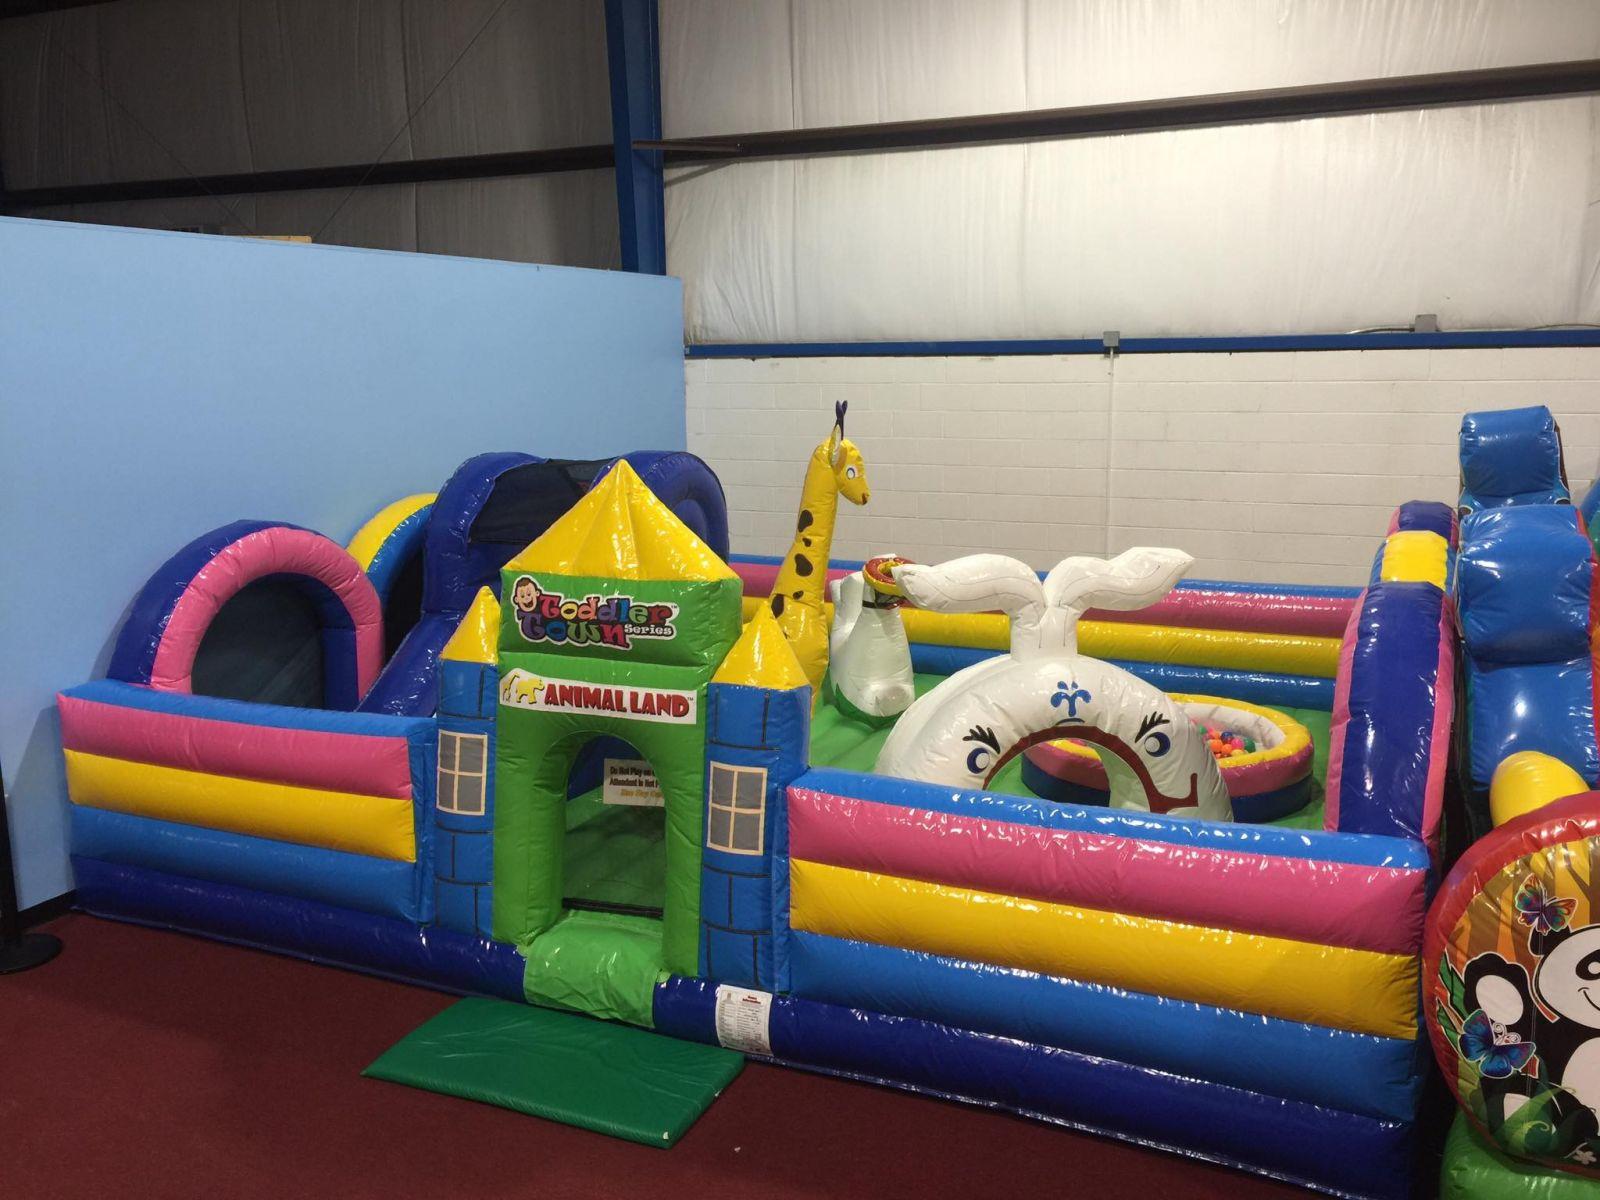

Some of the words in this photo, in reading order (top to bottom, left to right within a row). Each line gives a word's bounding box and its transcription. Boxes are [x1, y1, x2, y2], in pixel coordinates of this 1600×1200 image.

[539, 595, 673, 625] Toddler
[517, 608, 630, 649] Town
[624, 623, 673, 636] Series
[544, 683, 627, 714] ANIMAL
[630, 691, 690, 718] LAND
